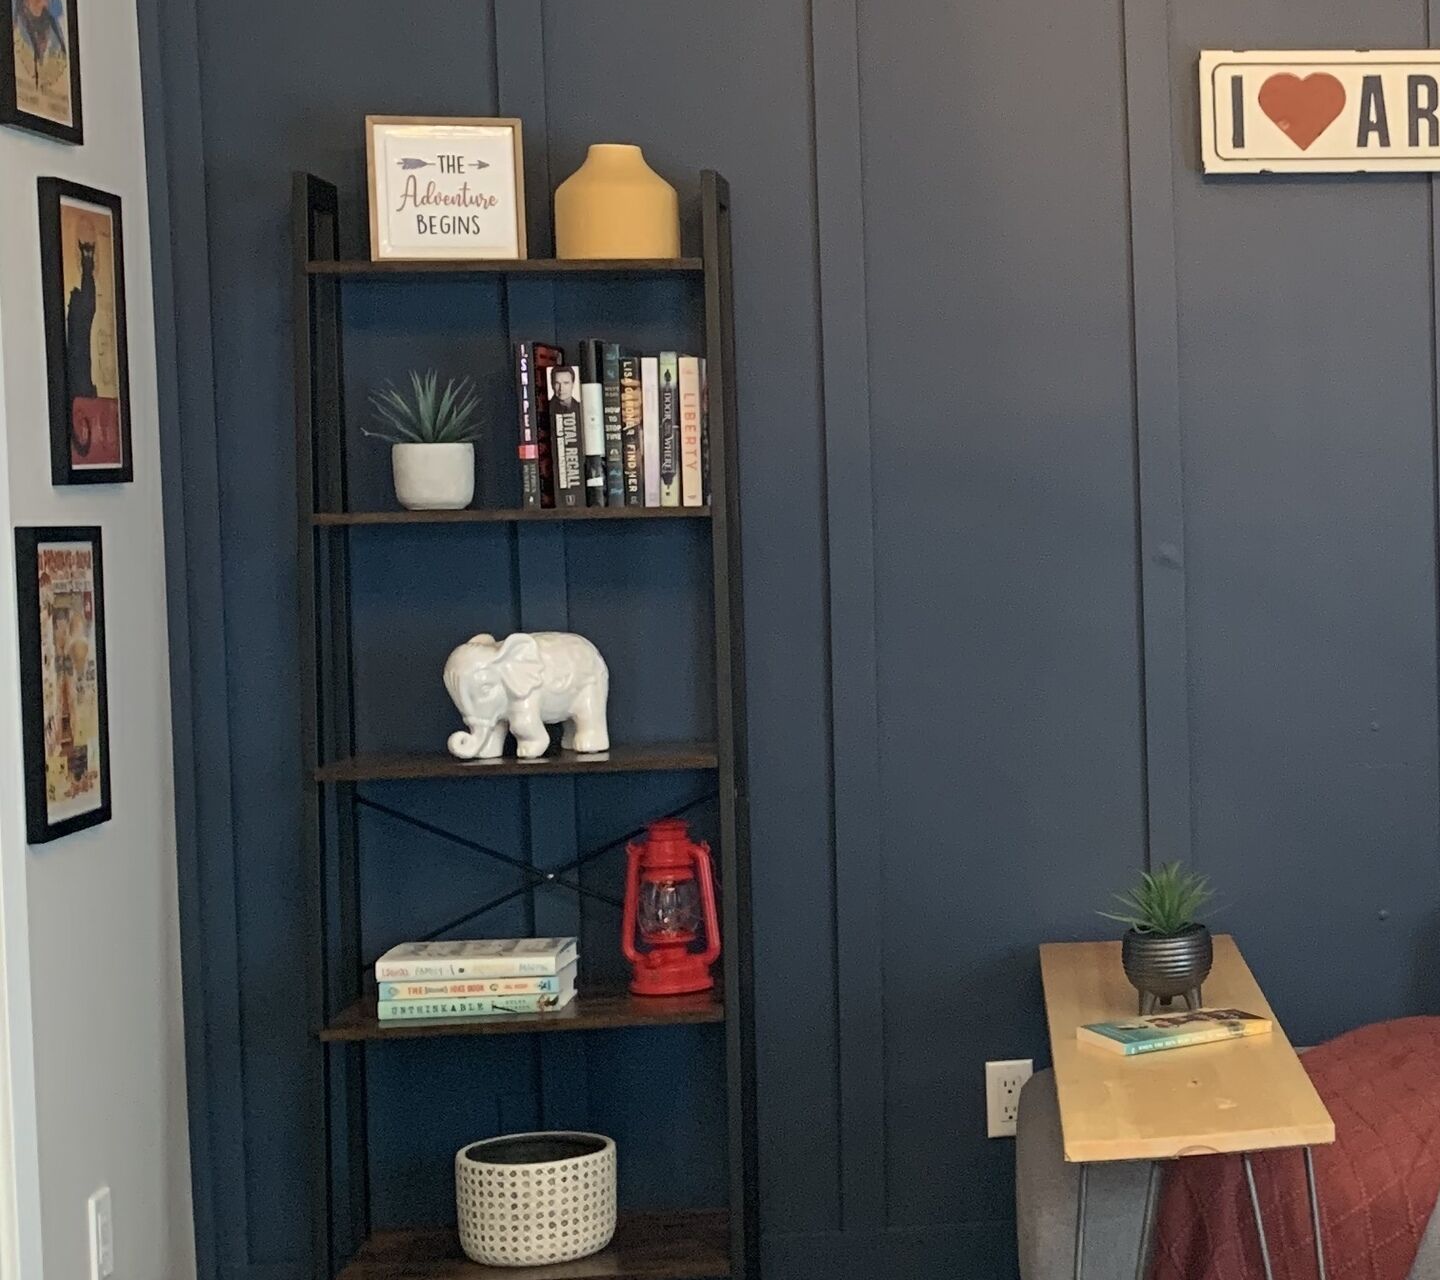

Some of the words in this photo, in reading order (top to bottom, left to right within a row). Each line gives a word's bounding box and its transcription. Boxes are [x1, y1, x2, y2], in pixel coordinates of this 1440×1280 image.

[1231, 74, 1245, 149] I
[1356, 74, 1391, 148] A
[437, 154, 465, 174] THE
[396, 174, 498, 212] Adventure
[416, 214, 480, 235] BEGINS
[623, 361, 633, 384] LISA
[563, 412, 577, 445] TOTAL
[684, 393, 698, 471] LIBERTY
[626, 444, 637, 468] FIND
[565, 448, 580, 489] RECALL
[626, 470, 639, 492] HER
[391, 1003, 484, 1016] UNTHINKABLE
